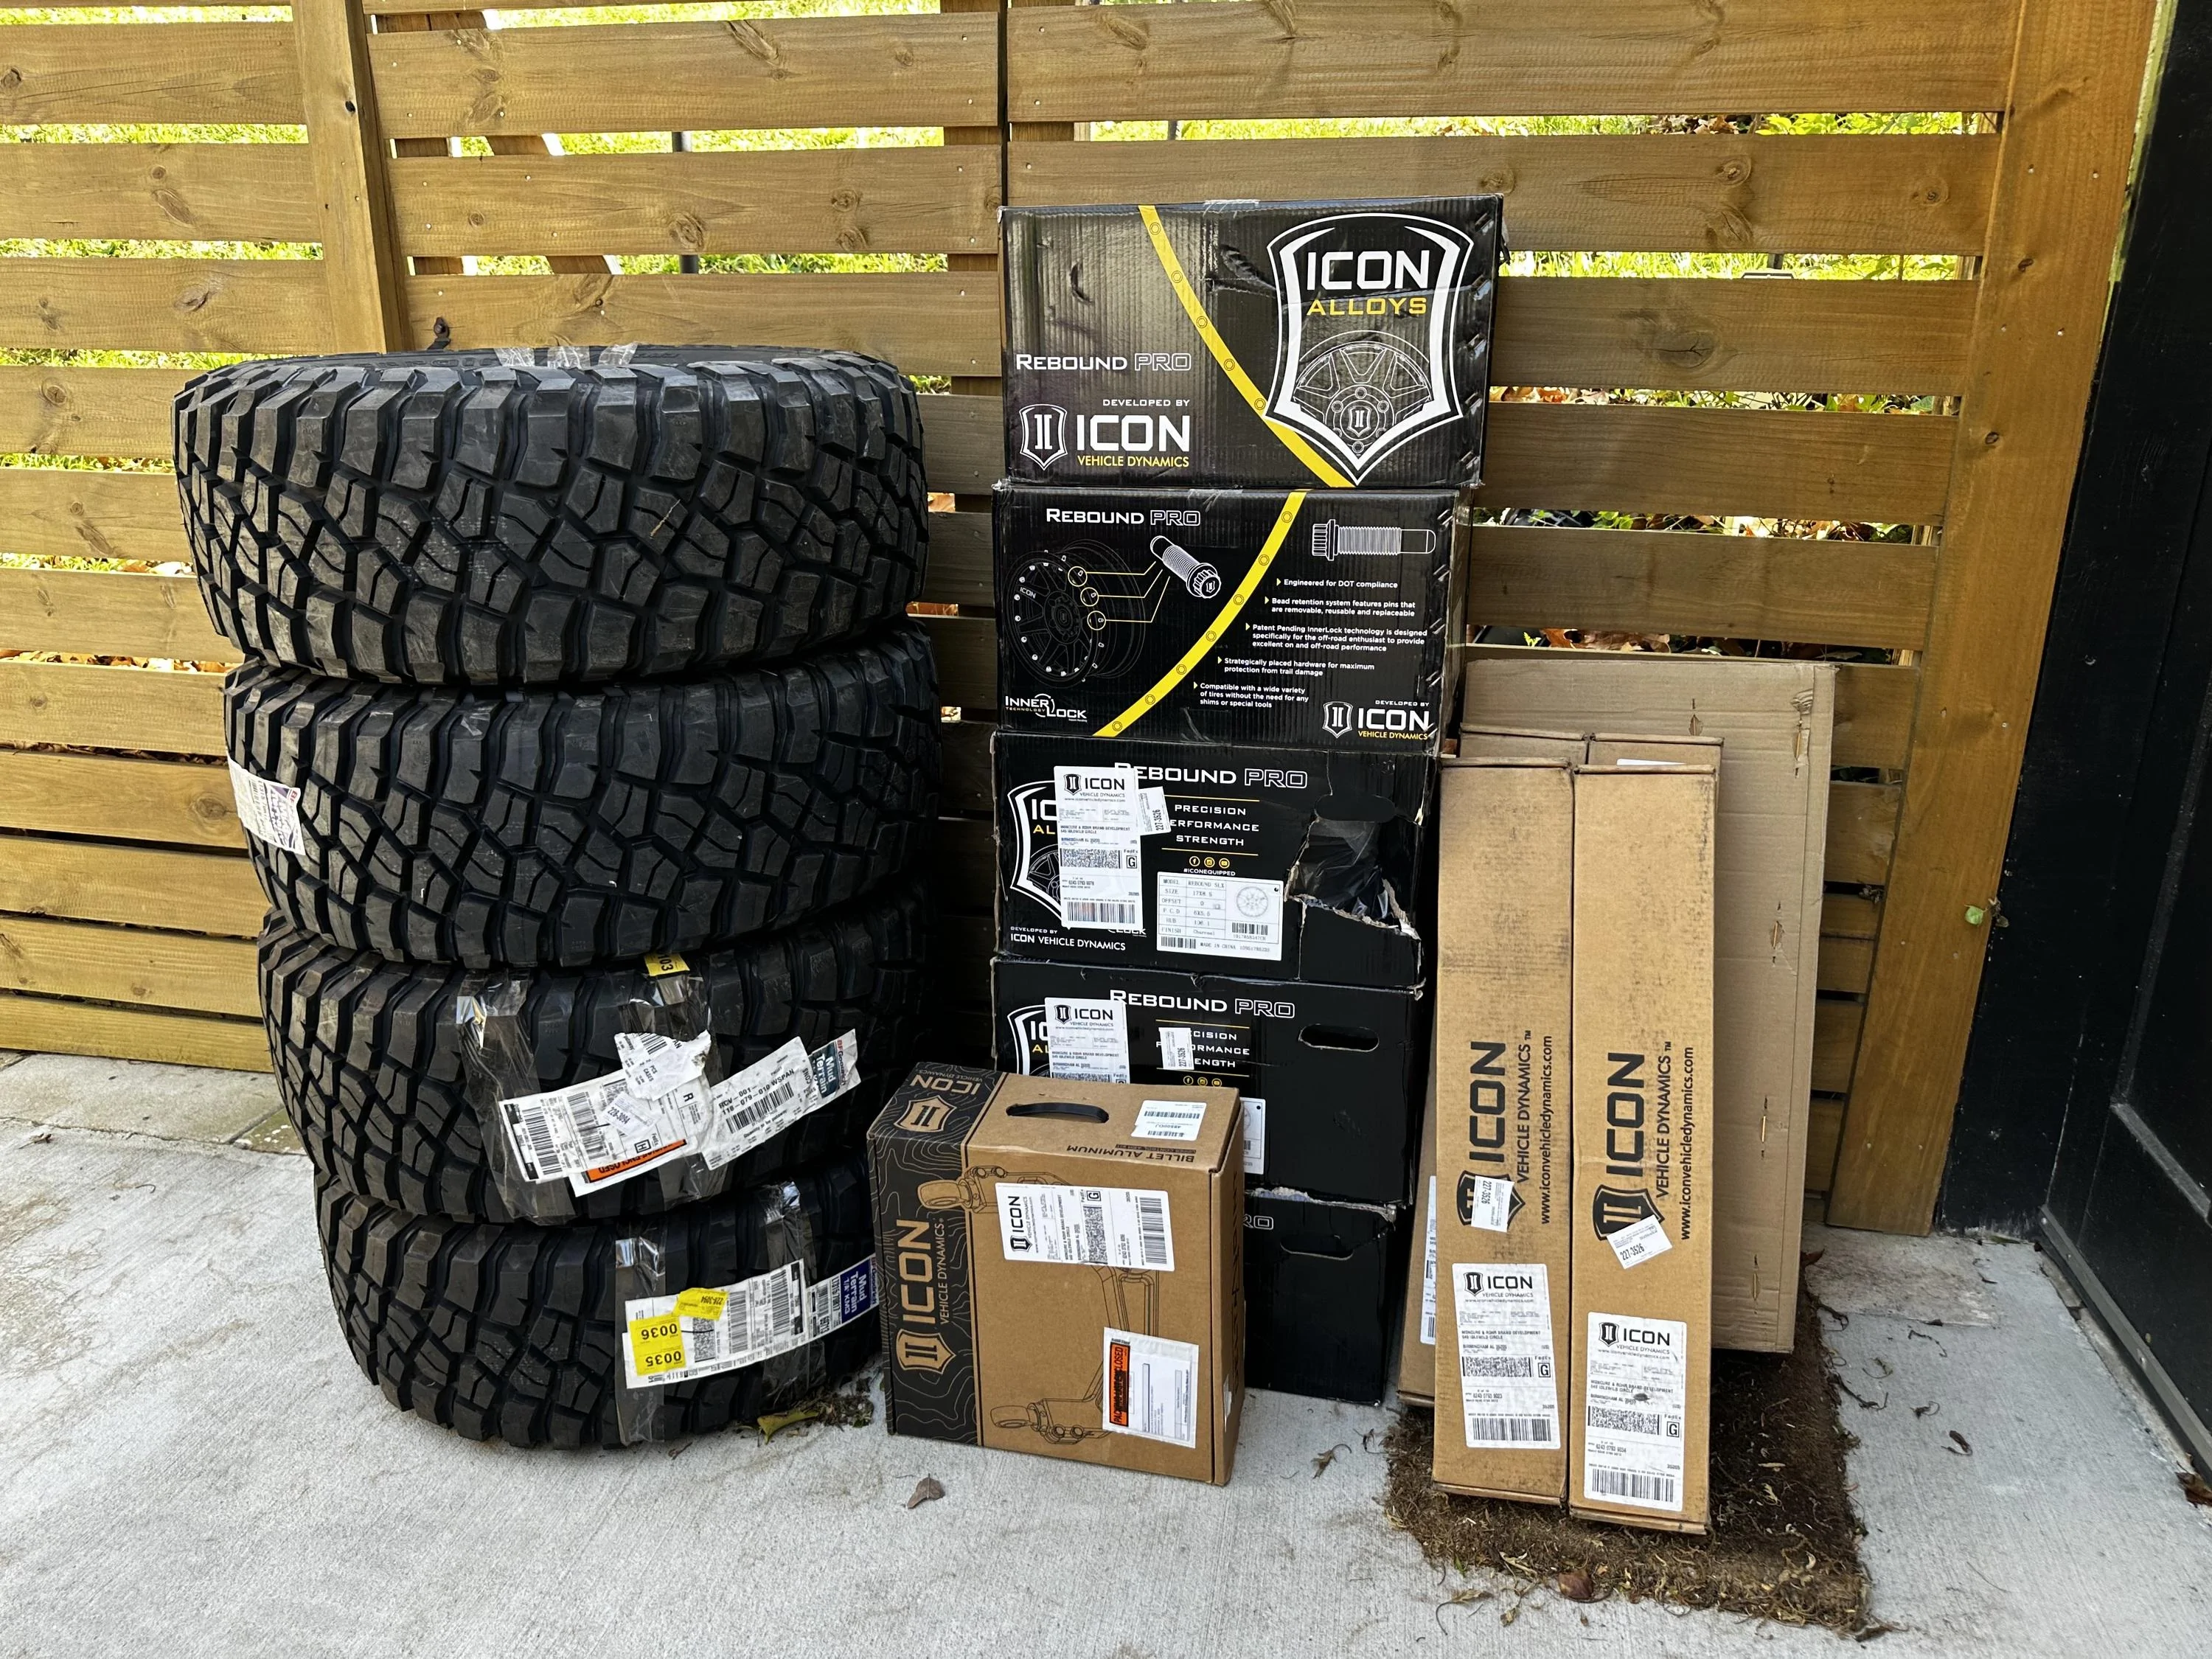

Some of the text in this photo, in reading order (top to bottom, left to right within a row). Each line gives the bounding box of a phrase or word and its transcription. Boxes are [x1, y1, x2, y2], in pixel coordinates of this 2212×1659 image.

[1307, 250, 1430, 291] ICON
[1307, 296, 1427, 316] ALLOYS
[1016, 352, 1192, 371] REBOUND PRO
[1102, 399, 1190, 407] DEVELOPED BY
[1077, 414, 1190, 452] ICON
[1077, 455, 1189, 467] VEHICLE DYNAMICS
[1046, 508, 1201, 526] REBOUND PRO
[1284, 579, 1324, 588] Engineered
[1356, 581, 1398, 589] compliance
[1020, 586, 1037, 599] ICON
[1284, 607, 1324, 615] removable,
[1325, 599, 1351, 608] system
[1352, 599, 1382, 608] features
[1383, 600, 1399, 609] pins
[1277, 625, 1306, 633] Pending
[1344, 627, 1384, 636] technology
[1394, 629, 1427, 637] designed
[1253, 633, 1291, 641] specifically
[1349, 636, 1385, 644] enthusiast
[1397, 637, 1425, 646] provide
[1310, 642, 1340, 650] off-road
[1341, 644, 1387, 652] performance
[1224, 657, 1267, 667] Strategically
[1268, 658, 1293, 667] placed
[1293, 660, 1326, 668] hardware
[1224, 666, 1260, 675] protection
[1295, 669, 1324, 677] damage
[1200, 683, 1239, 692] Compatible
[1281, 686, 1306, 695] variety
[1005, 695, 1048, 708] INNER
[1230, 700, 1253, 708] special
[1357, 708, 1430, 731] ICON
[1358, 730, 1428, 740] VEHICLE DYNAMICS
[1085, 777, 1125, 790] ICON
[1244, 768, 1308, 789] PRO
[1175, 804, 1246, 815] PRECISION
[1169, 819, 1259, 832] ERFORMANCE
[1176, 834, 1244, 846] STRENGTH
[1128, 857, 1135, 867] G
[1183, 868, 1236, 877] #ICONEQUIPPED
[1010, 933, 1126, 951] ICON VEHICLE DYNAMICS
[1074, 1008, 1113, 1020] ICON
[1234, 998, 1295, 1019] PRO
[771, 1068, 795, 1086] WSPAN
[816, 1053, 827, 1094] Terrain
[825, 1056, 836, 1083] Mud
[919, 1069, 983, 1082] VEHICLE DYNAMICS
[910, 1074, 981, 1095] ICON
[683, 1092, 694, 1102] R
[1469, 1041, 1506, 1163] ICON
[1517, 1043, 1531, 1183] VEHICLE DYNAMICS
[1606, 1052, 1645, 1177] ICON
[1540, 1035, 1554, 1225] www.iconvehicledynamics.com
[1656, 1055, 1671, 1198] VEHICLE DYNAMICS
[1680, 1047, 1695, 1240] www.iconvehicledynamics.com
[1066, 1144, 1195, 1163] BILLET ALUMINUM
[1088, 1192, 1099, 1200] G
[1481, 1180, 1492, 1205] 227-3526
[1007, 1195, 1025, 1233] ICON
[1619, 1243, 1645, 1261] 227-3526
[896, 1219, 936, 1324] ICON
[933, 1222, 950, 1325] VEHICLE DYNAMICS
[858, 1273, 868, 1301] Mud
[1487, 1276, 1533, 1289] ICON
[850, 1270, 859, 1313] Terrain
[641, 1324, 678, 1340] 0036
[1623, 1328, 1670, 1346] ICON
[1640, 1346, 1670, 1354] DYNAMICS
[645, 1350, 681, 1367] 0035
[1540, 1364, 1549, 1376] G
[1669, 1423, 1677, 1436] G
